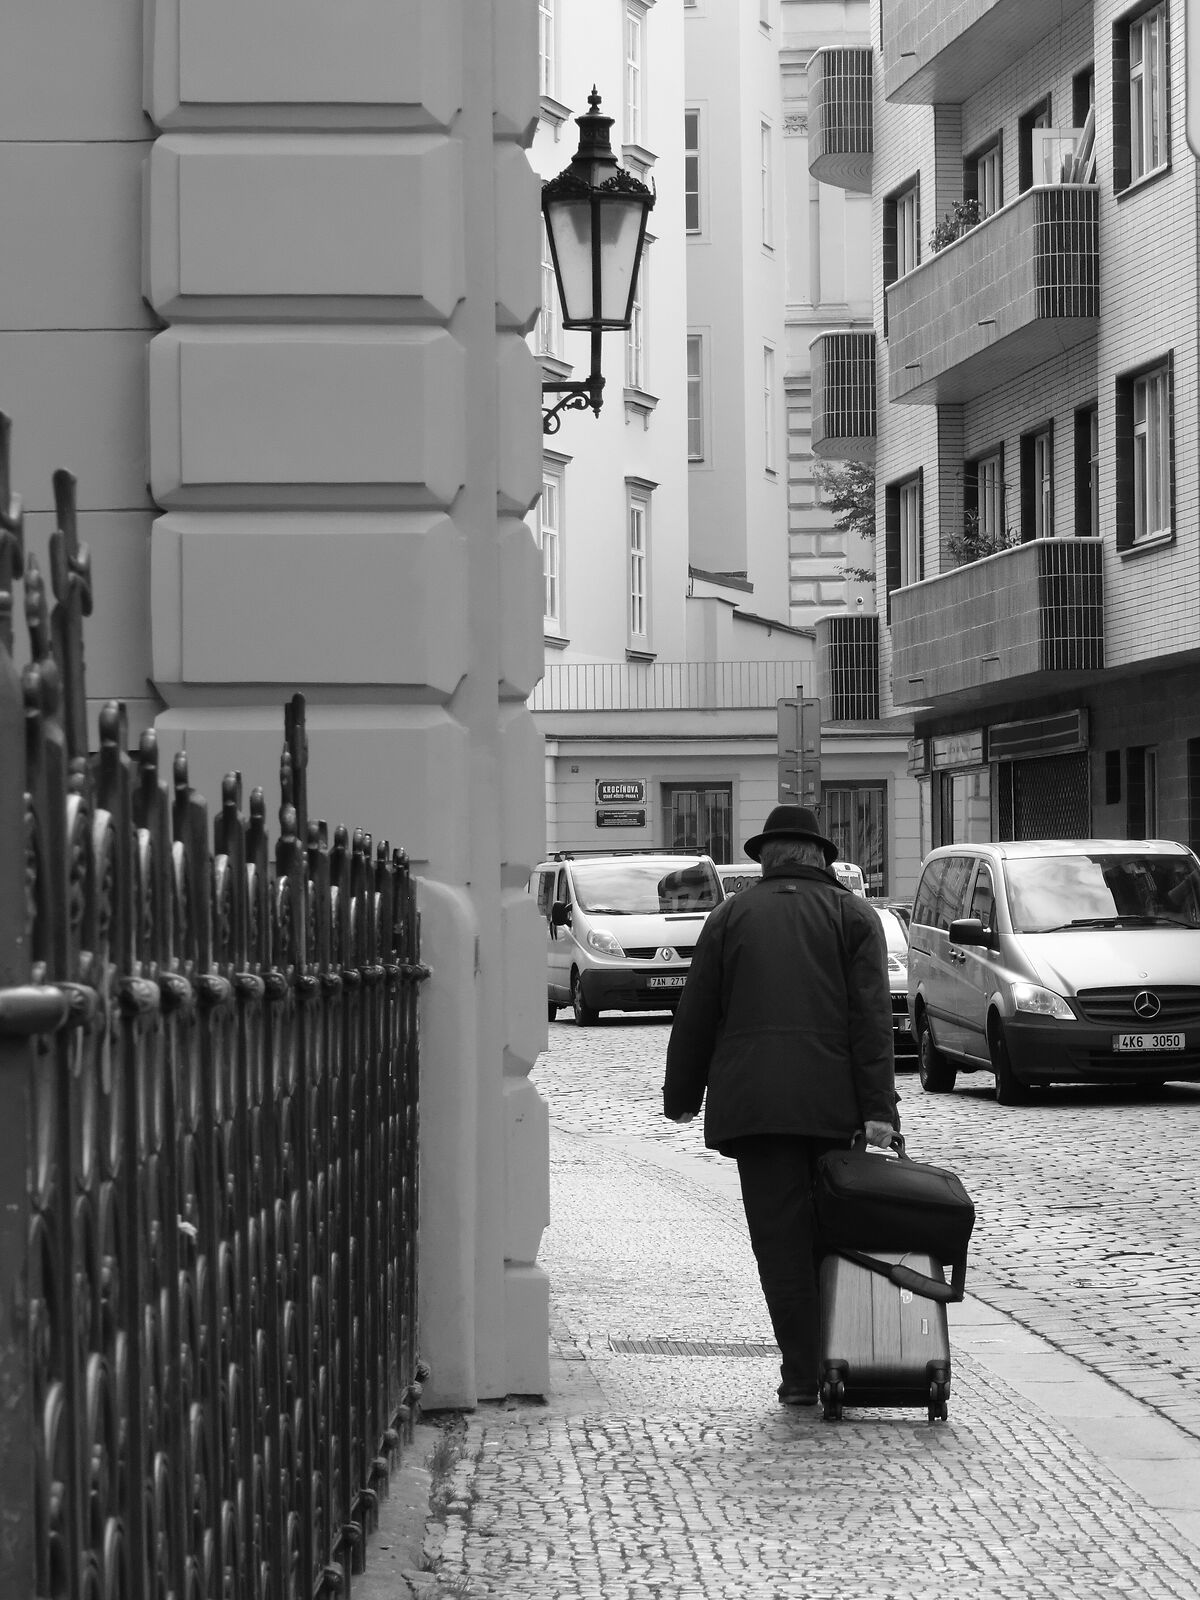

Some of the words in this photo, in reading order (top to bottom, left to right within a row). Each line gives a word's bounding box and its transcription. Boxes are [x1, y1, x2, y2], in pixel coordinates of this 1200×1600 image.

[602, 784, 639, 793] KROCÍNOVA
[652, 978, 666, 986] 7AN
[670, 977, 687, 986] 271
[1122, 1036, 1144, 1048] 4K6
[1152, 1035, 1180, 1047] 3050
